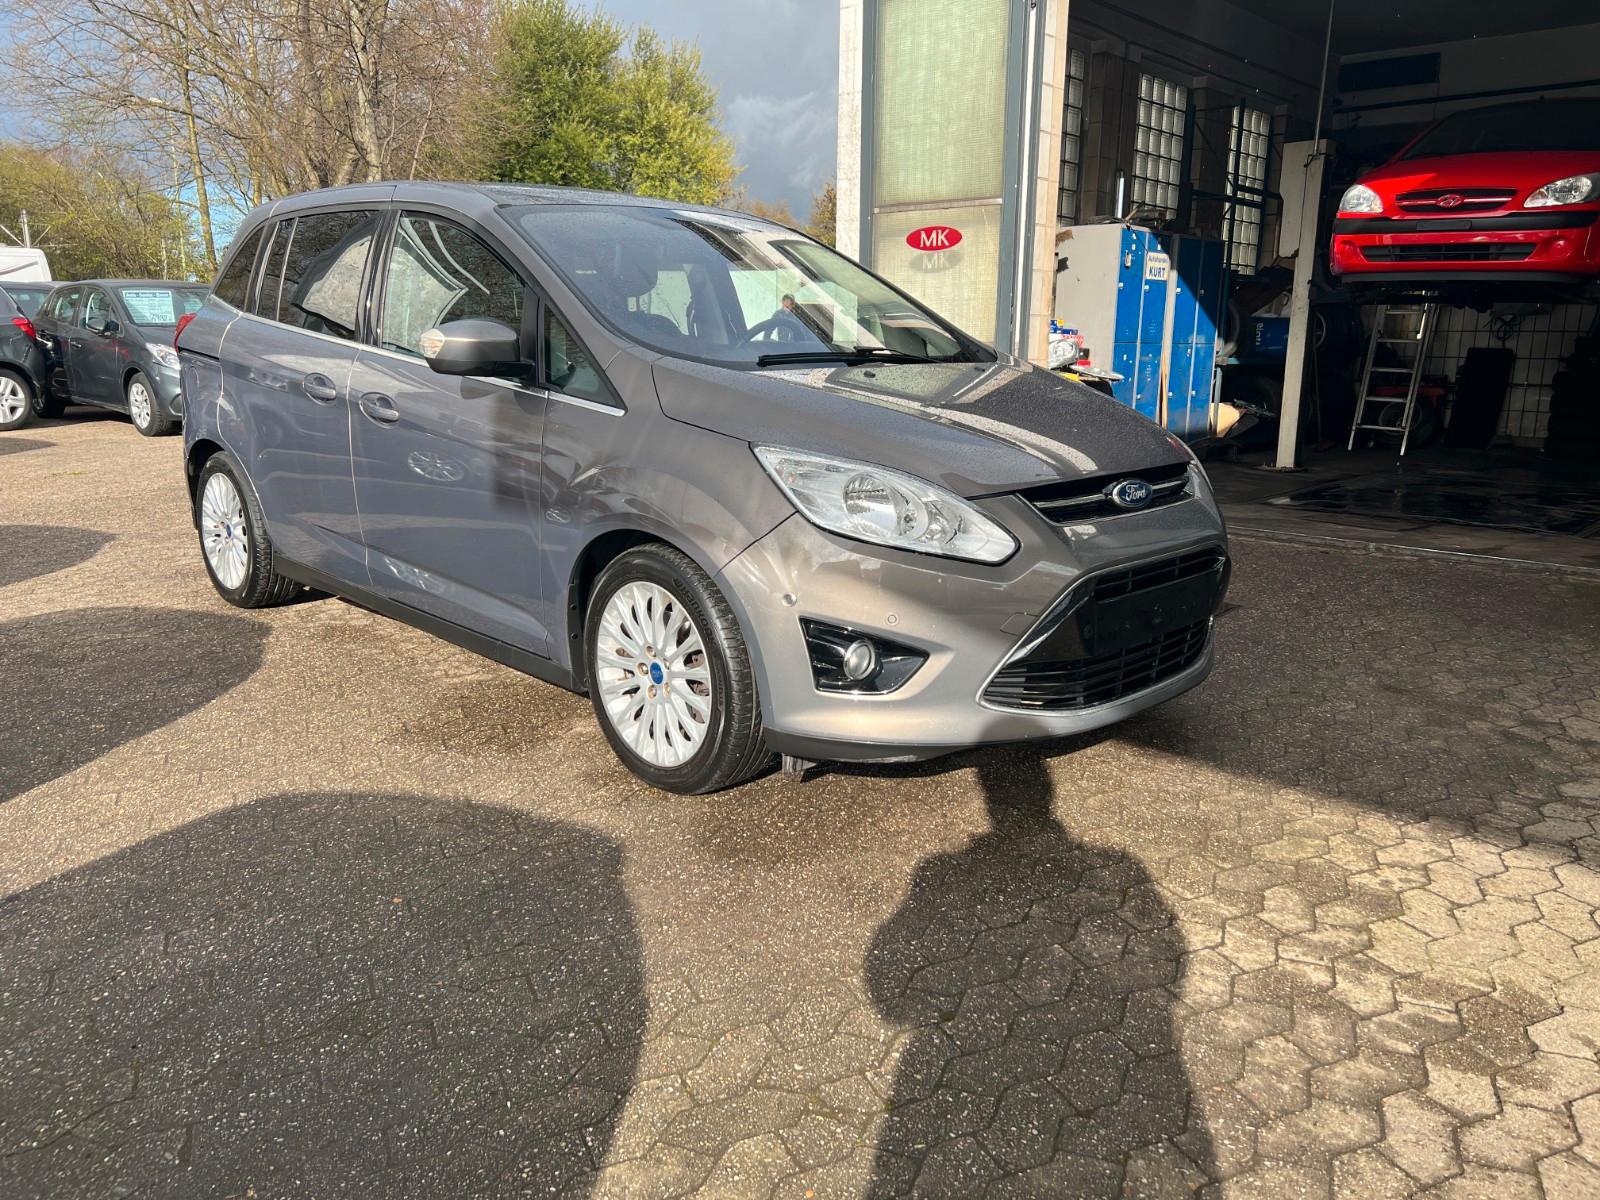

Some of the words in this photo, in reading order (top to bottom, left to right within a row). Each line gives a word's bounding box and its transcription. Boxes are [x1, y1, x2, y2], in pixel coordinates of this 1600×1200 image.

[919, 228, 950, 247] MK
[1149, 265, 1165, 278] KURT
[1125, 484, 1146, 501] Ford
